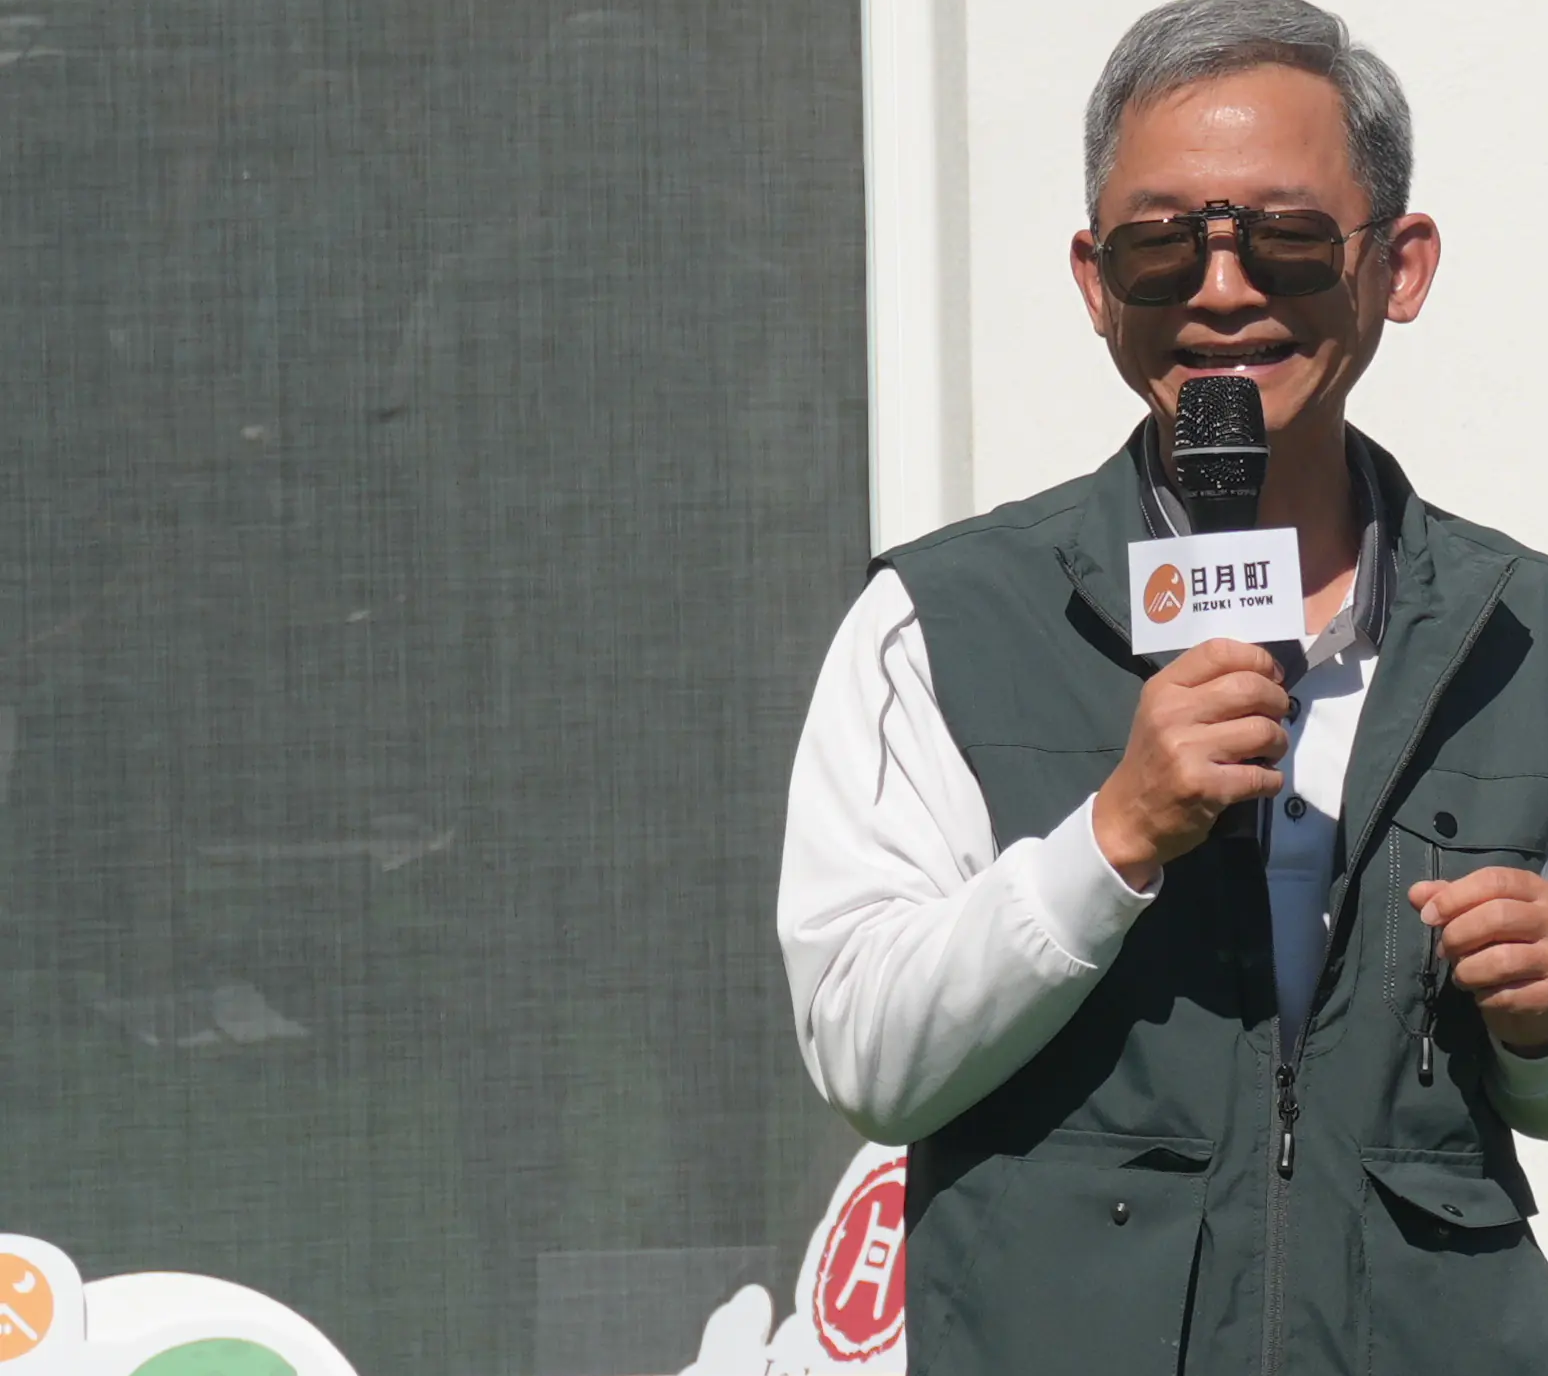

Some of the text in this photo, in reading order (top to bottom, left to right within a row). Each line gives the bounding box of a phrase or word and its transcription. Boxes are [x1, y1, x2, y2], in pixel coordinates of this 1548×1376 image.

[1191, 560, 1271, 597] 日月町
[1192, 595, 1274, 612] HIZUKI TOWN
